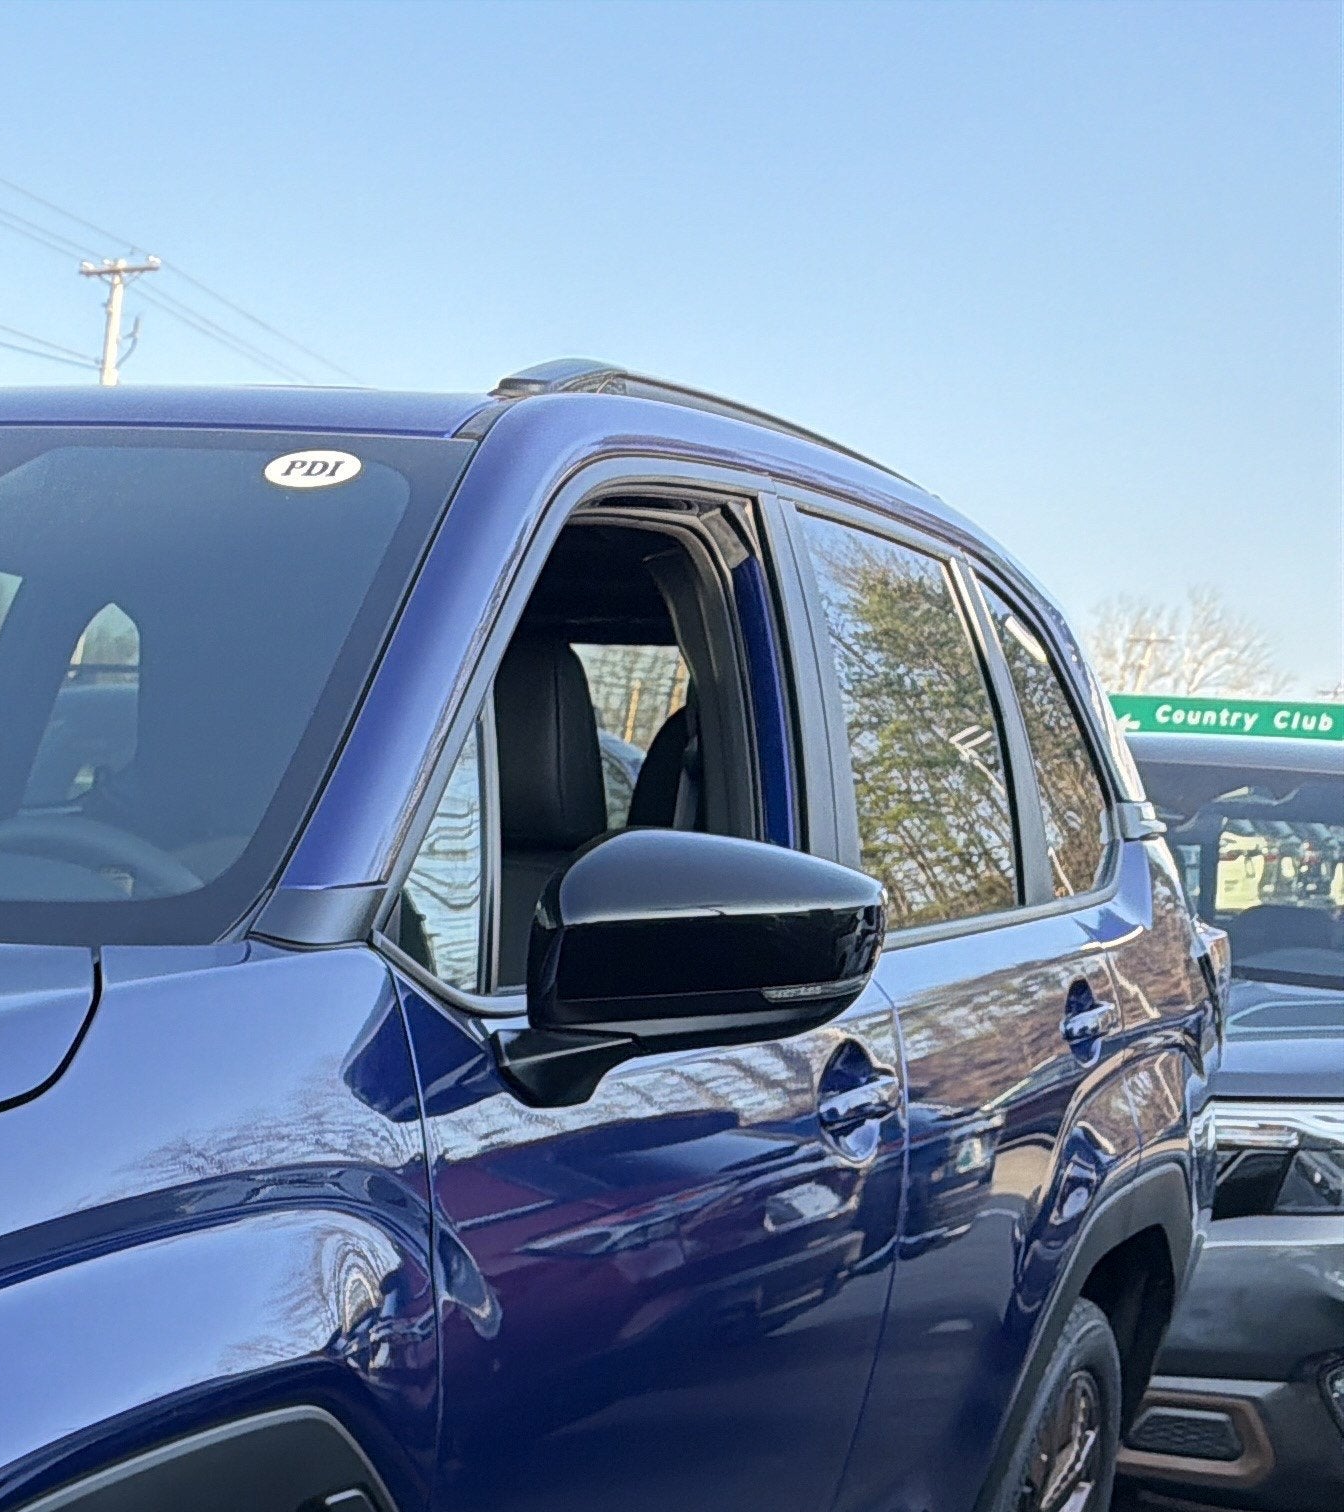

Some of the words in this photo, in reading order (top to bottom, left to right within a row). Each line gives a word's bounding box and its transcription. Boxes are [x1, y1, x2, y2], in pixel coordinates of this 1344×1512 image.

[281, 460, 345, 477] PDI
[1155, 704, 1259, 731] Country
[1273, 710, 1333, 731] Club
